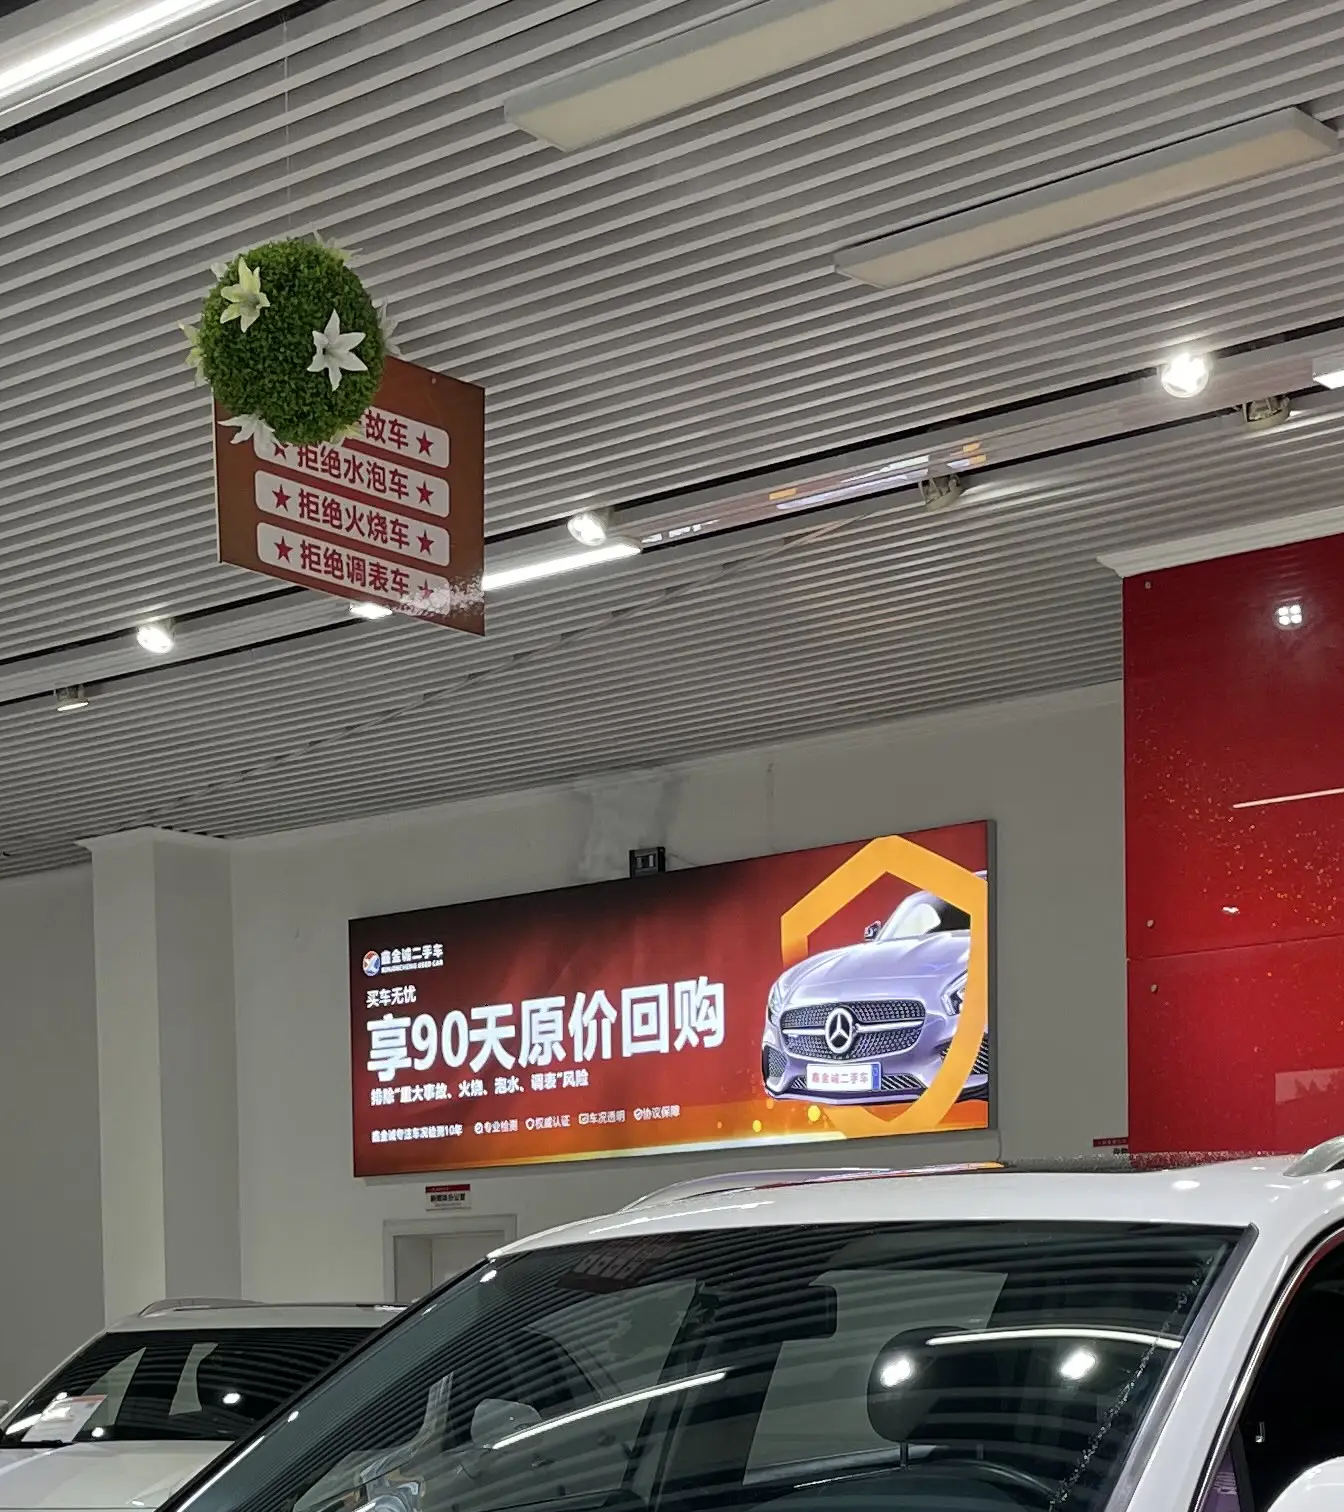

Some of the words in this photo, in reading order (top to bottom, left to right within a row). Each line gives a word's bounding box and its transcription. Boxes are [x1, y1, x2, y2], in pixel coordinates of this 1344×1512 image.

[357, 410, 409, 449] 故车
[296, 445, 410, 500] 拒绝水泡车
[298, 488, 410, 549] 拒绝火烧车
[299, 539, 410, 597] 拒绝调表车
[366, 984, 417, 1009] 买车无忧
[366, 976, 725, 1081] 享90天原价回购
